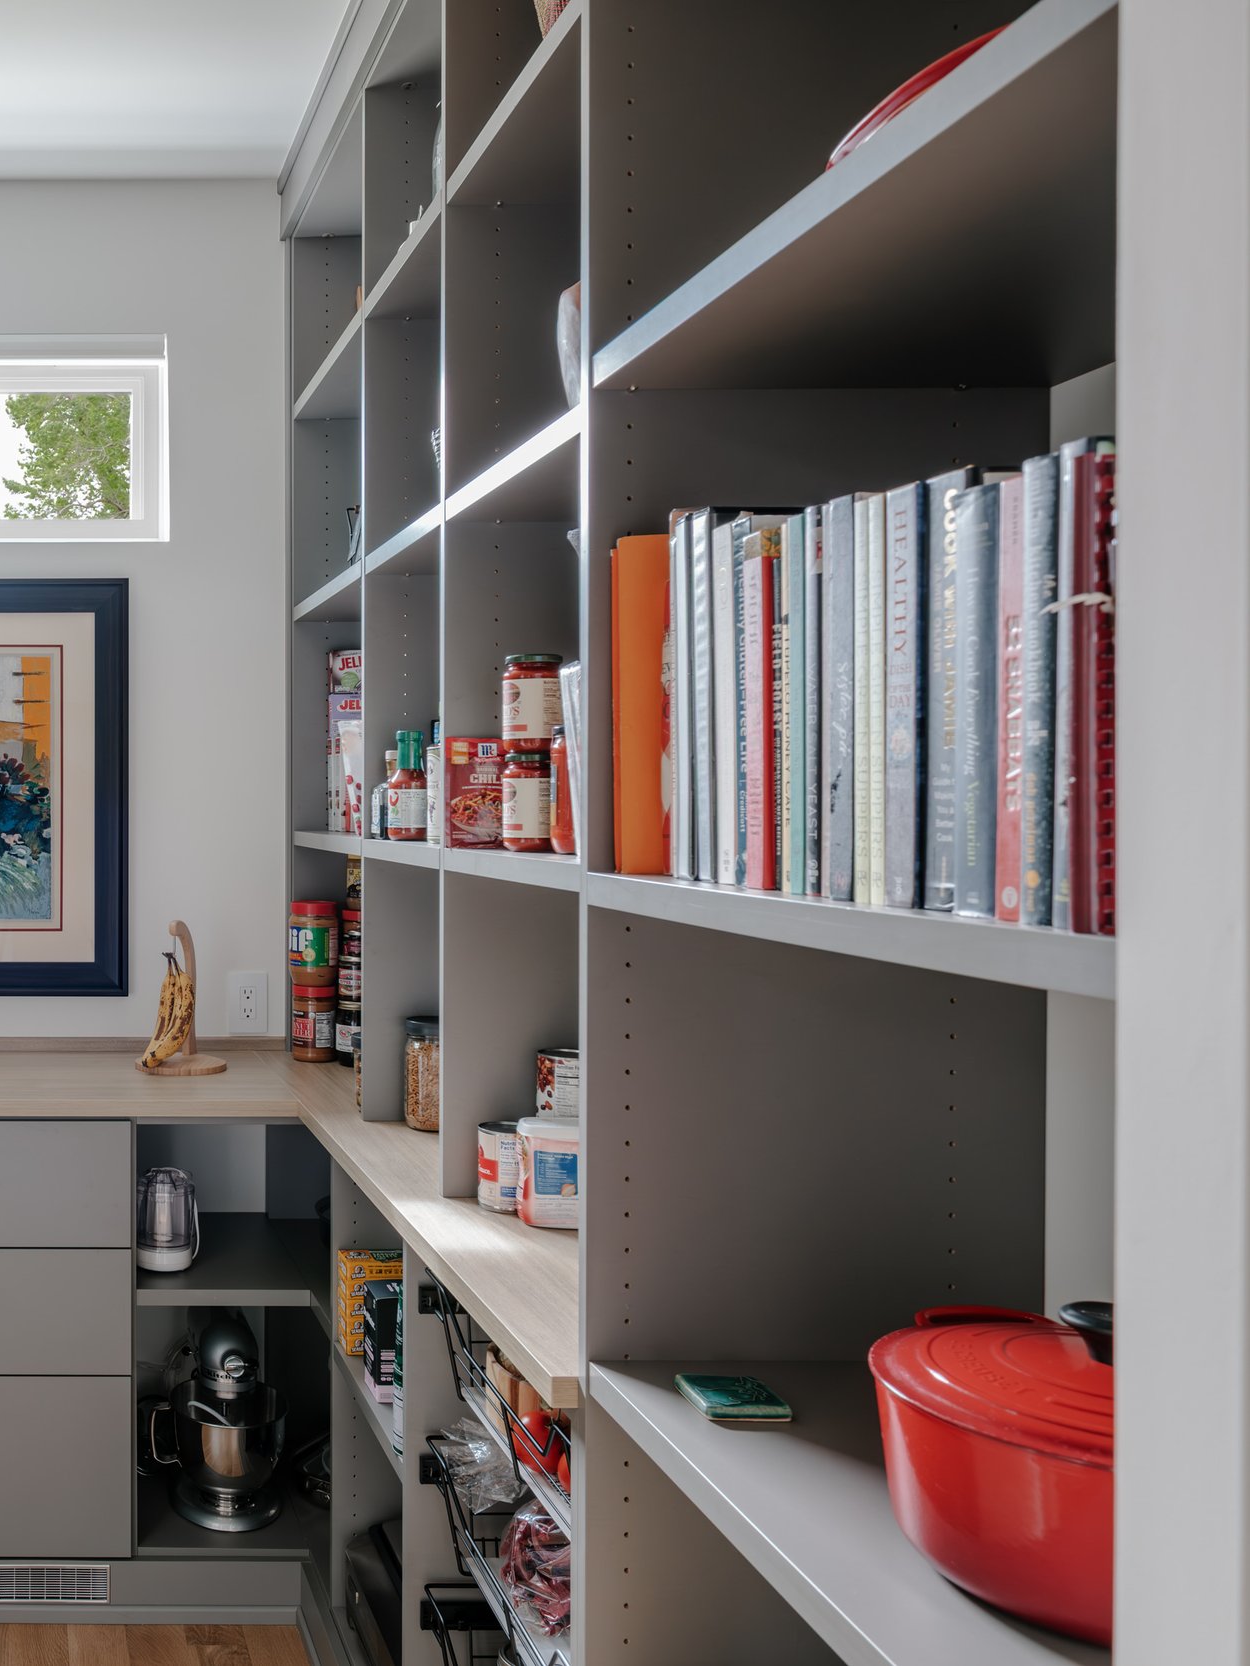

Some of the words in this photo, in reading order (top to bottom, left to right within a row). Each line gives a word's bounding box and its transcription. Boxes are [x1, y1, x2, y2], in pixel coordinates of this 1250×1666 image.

[857, 573, 868, 655] SIMPLE
[871, 570, 883, 655] SIMPLE
[894, 508, 908, 657] HEALTHY
[933, 563, 942, 612] JAMIE
[933, 617, 942, 673] OLIVER
[967, 636, 979, 680] Cook
[807, 663, 817, 724] WATER
[857, 665, 868, 746] GREEN
[871, 663, 883, 746] GREEN
[889, 694, 912, 708] DAY
[963, 687, 979, 776] Everything
[1006, 657, 1022, 811] SHABBATS
[808, 783, 817, 840] YEAST
[857, 756, 868, 857] SUPPERS
[871, 755, 883, 858] SUPPERS
[963, 780, 979, 866] Vegetarian
